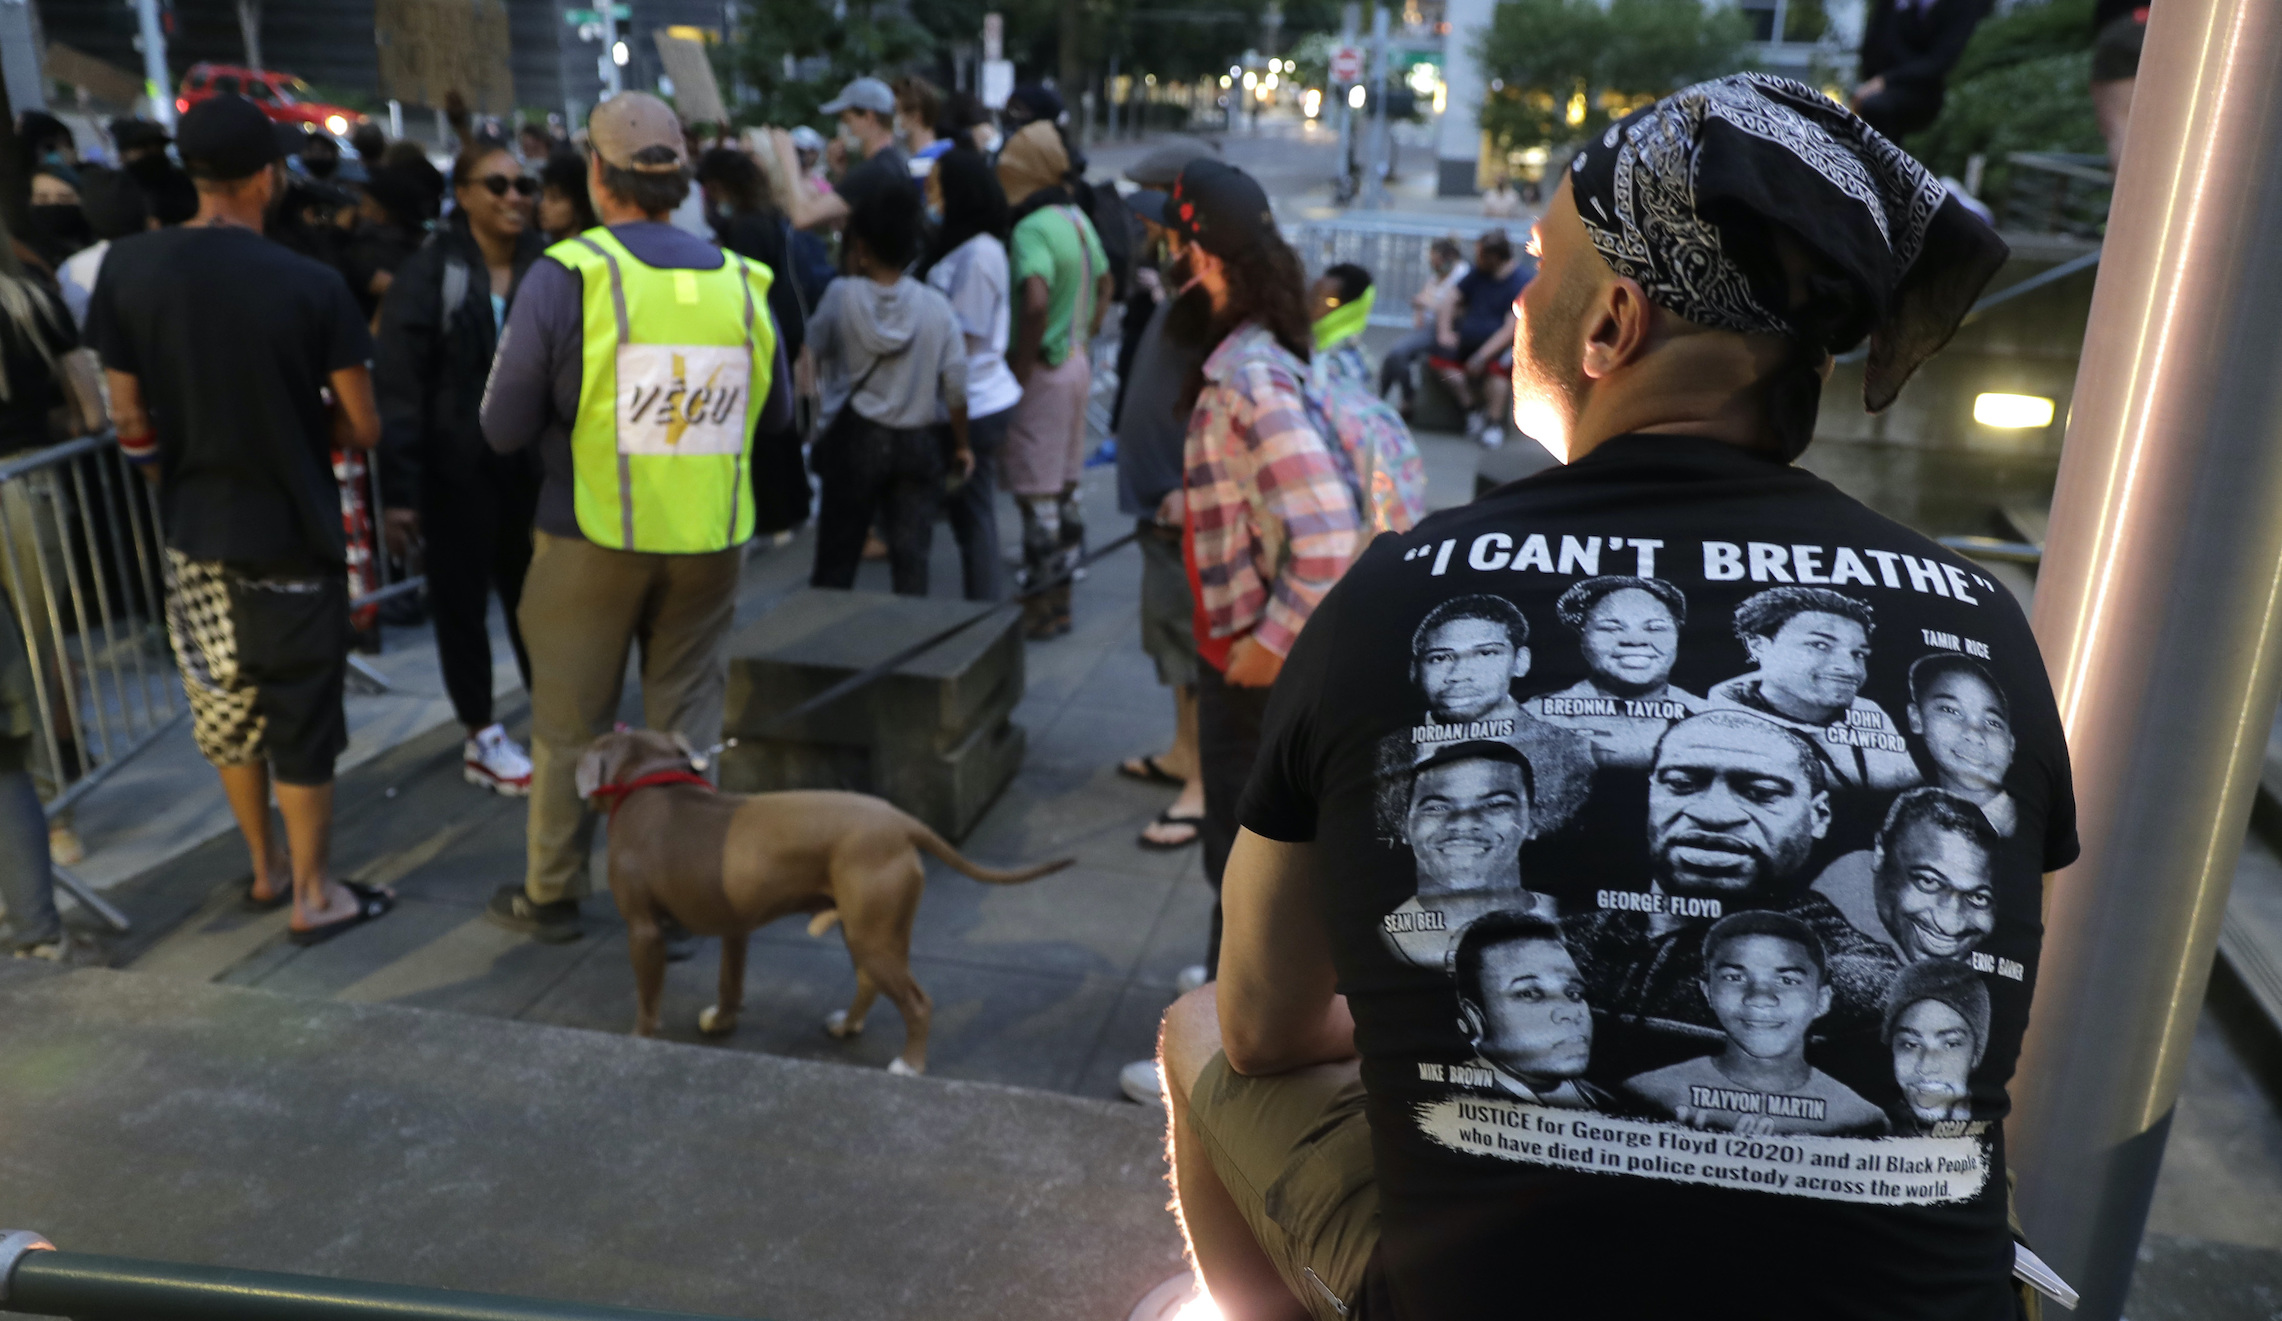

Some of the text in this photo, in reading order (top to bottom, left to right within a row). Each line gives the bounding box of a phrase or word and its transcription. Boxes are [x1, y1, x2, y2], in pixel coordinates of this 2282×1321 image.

[1468, 532, 1664, 579] CAN'T
[1921, 629, 1991, 660] TAMIR RICE
[1543, 698, 1685, 719] BREONNA TAYLOR
[1844, 709, 1882, 729] JOHN
[1411, 720, 1514, 744] JORDAN DAVIS
[1826, 726, 1906, 752] CRAWFORD
[1597, 889, 1722, 919] GEORGE FLOYD
[1384, 911, 1445, 933] SEAN BELL
[1972, 951, 1995, 974] ERIC
[1418, 1062, 1494, 1088] MIKE BROWN
[1690, 1086, 1826, 1120] TRAYVON MARTIN
[1458, 1102, 1531, 1131] JUSTICE
[1536, 1116, 1566, 1135] for
[1572, 1121, 1651, 1148] George
[1659, 1132, 1717, 1155] Floyd
[1725, 1139, 1803, 1164] (2020)
[1810, 1152, 1849, 1169] and
[1856, 1154, 1880, 1172] all
[1886, 1155, 1933, 1174] Black
[1459, 1127, 1952, 1198] who have died in police custody across the world.
